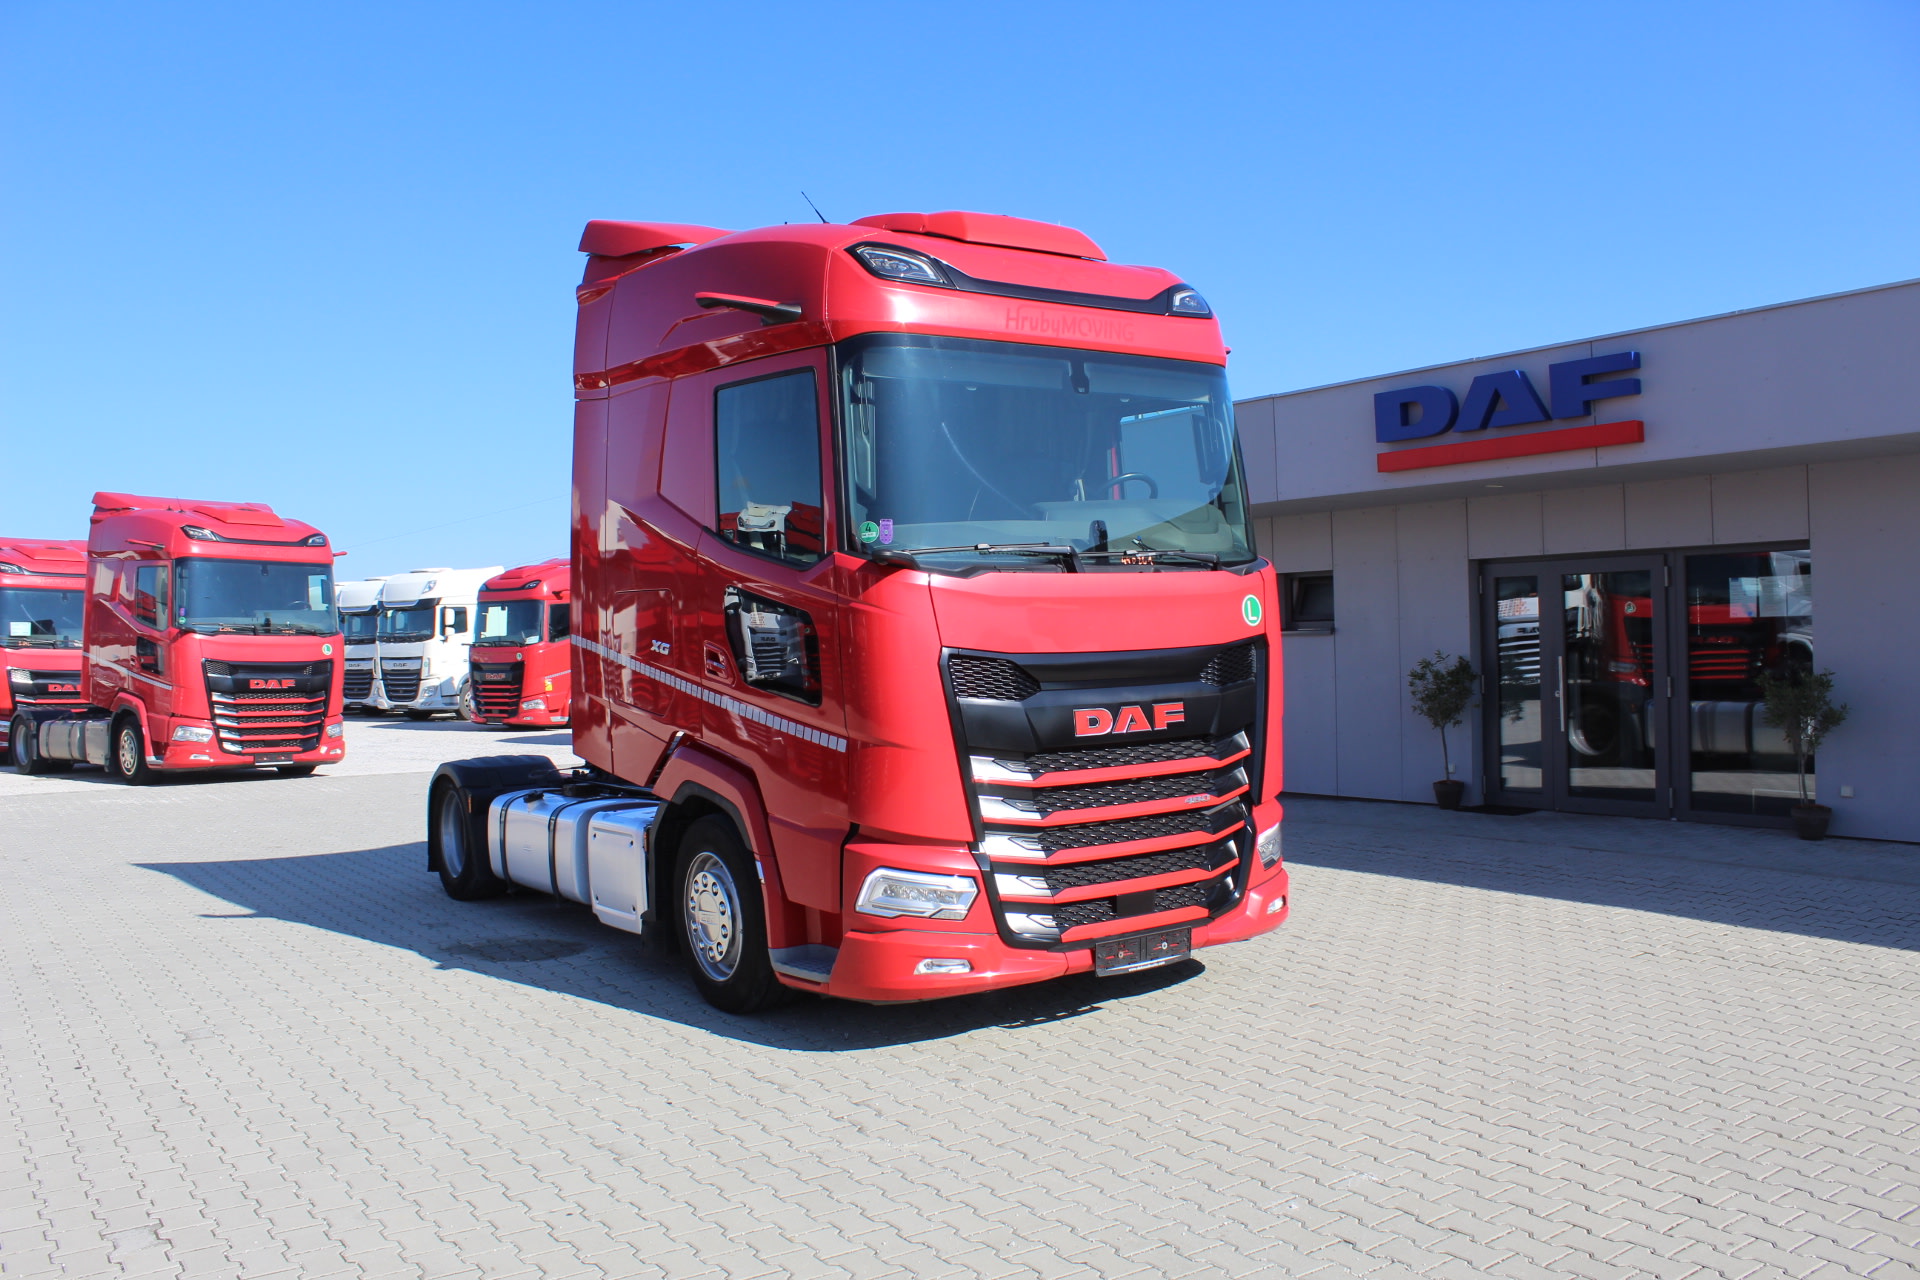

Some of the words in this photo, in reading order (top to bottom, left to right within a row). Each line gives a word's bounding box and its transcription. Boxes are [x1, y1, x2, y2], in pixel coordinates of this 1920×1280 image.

[1005, 308, 1135, 342] HrubyMOVING
[1374, 351, 1641, 443] DAF
[865, 522, 872, 532] 4
[1247, 600, 1259, 621] L
[249, 679, 296, 689] DAF
[1073, 701, 1185, 737] DAF
